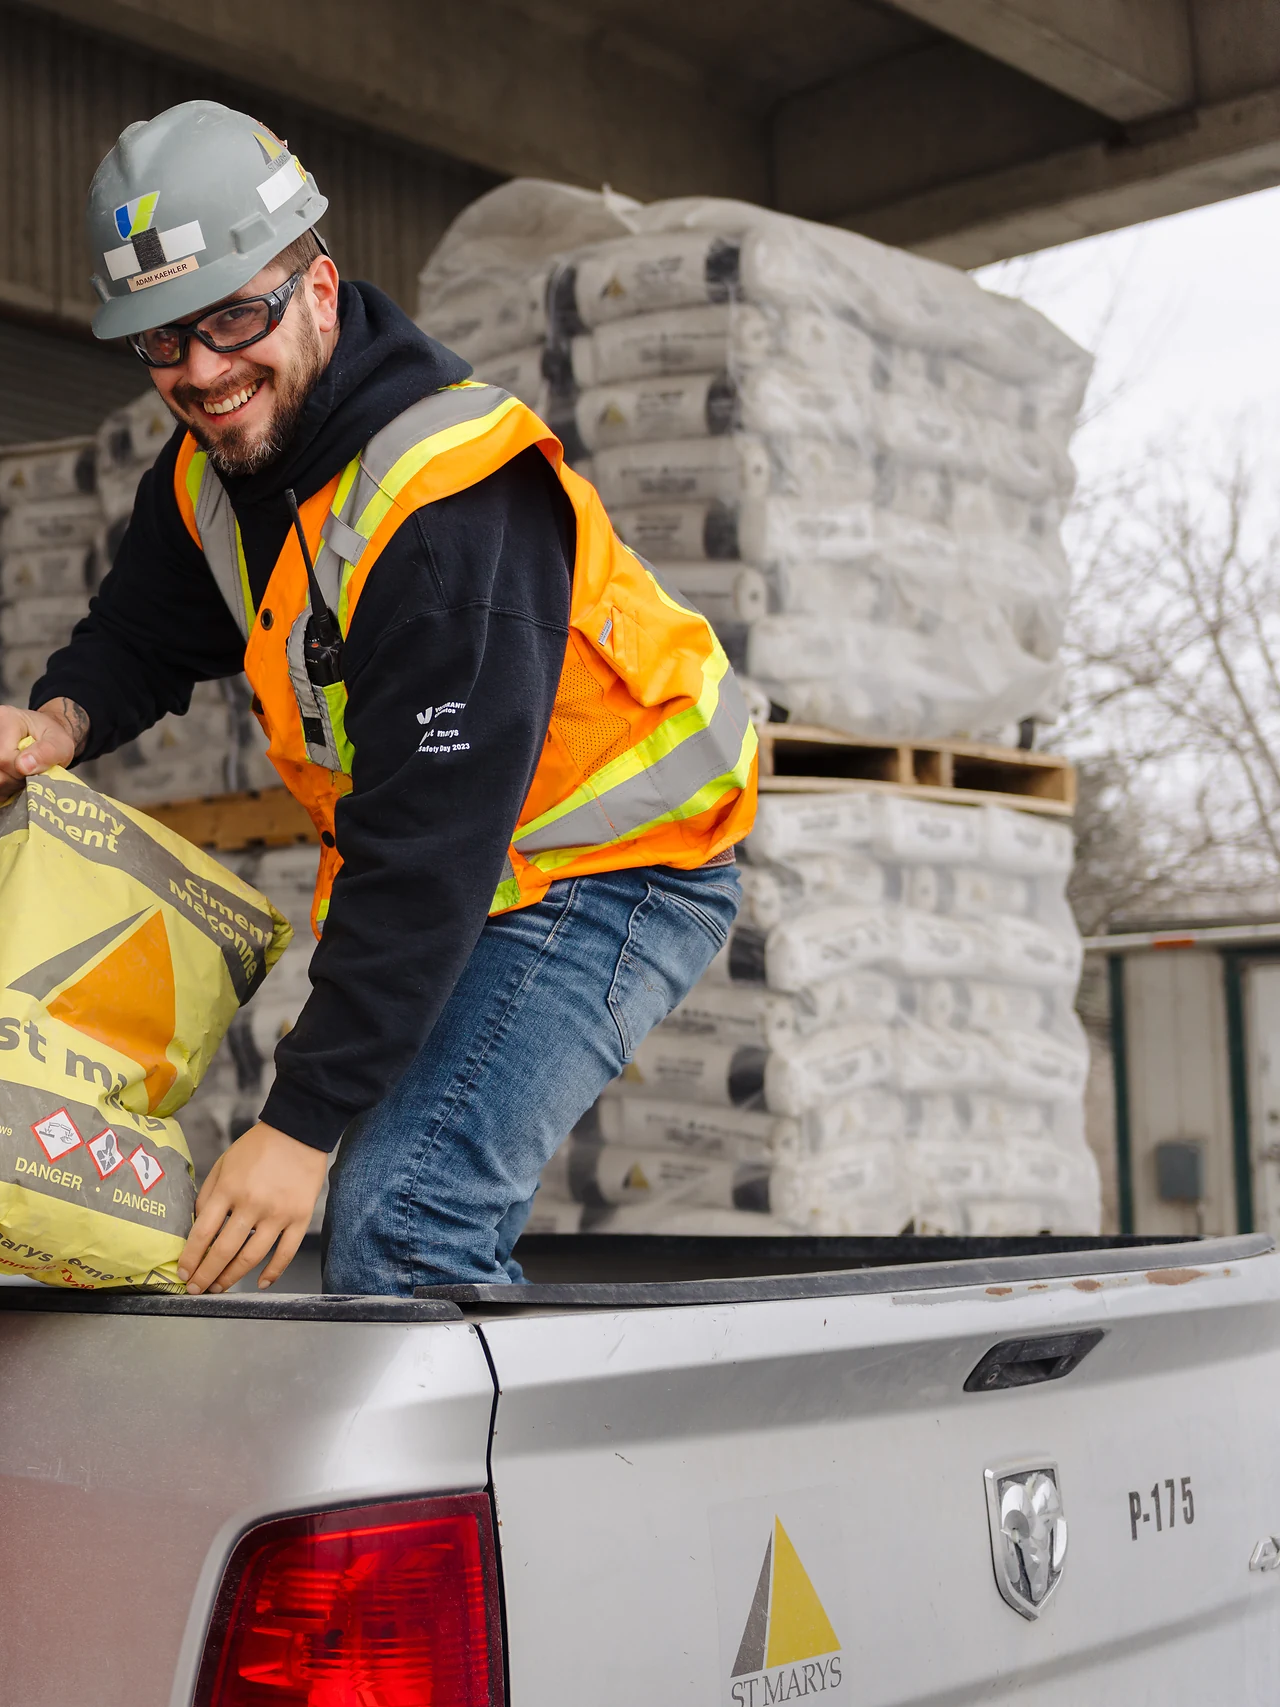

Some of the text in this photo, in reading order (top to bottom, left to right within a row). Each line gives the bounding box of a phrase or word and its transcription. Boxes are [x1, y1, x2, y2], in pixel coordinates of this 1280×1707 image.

[136, 263, 188, 287] ADAM KAEHLER
[451, 742, 470, 751] 2023
[26, 781, 126, 837] asonry
[27, 798, 119, 853] ement
[14, 1156, 83, 1191] DANGER
[112, 1188, 167, 1219] DANGER
[1128, 1476, 1195, 1541] P-175
[731, 1656, 843, 1707] ST MARYS
